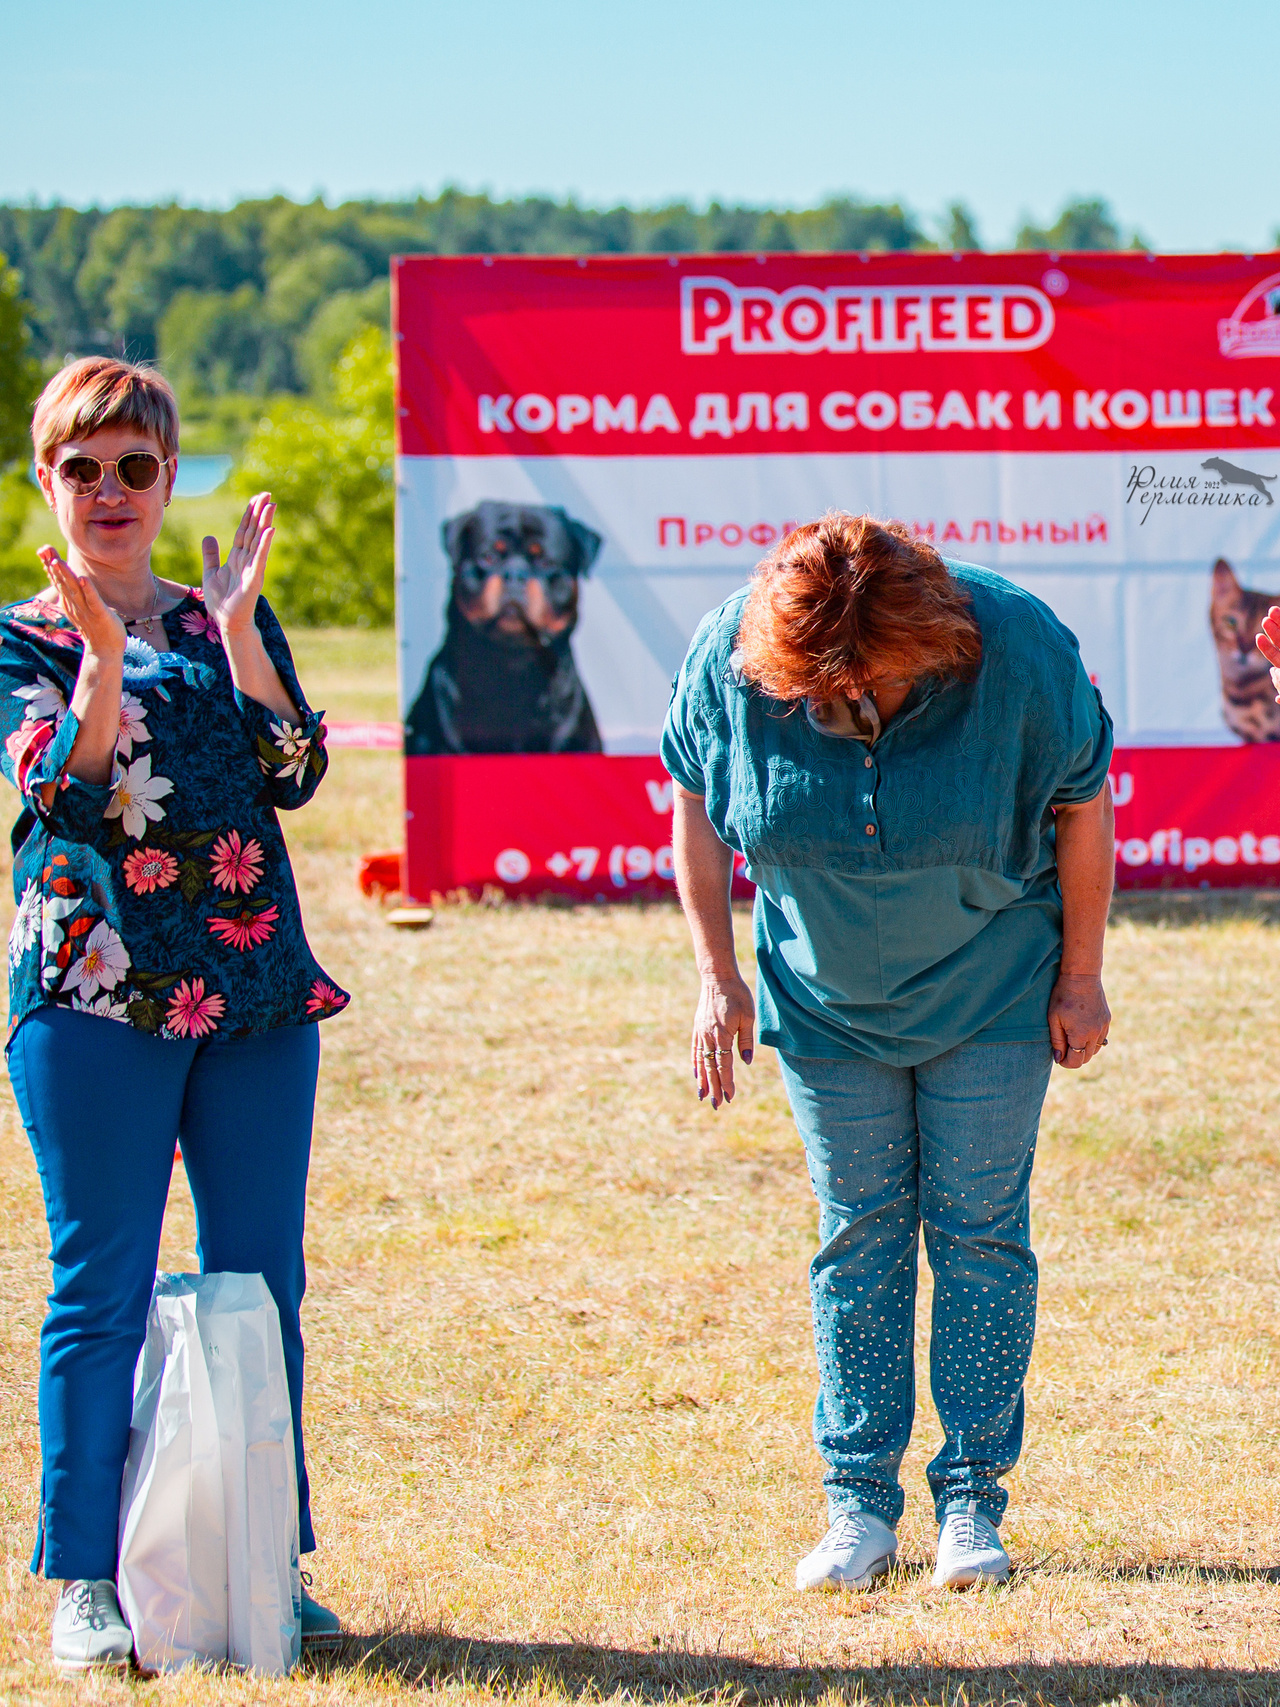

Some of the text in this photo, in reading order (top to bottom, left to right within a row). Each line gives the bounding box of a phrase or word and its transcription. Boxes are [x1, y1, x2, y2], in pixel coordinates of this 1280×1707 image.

[478, 387, 1276, 439] КОРМА ДЛЯ СОБАК И КОШЕК
[545, 845, 600, 881] +7
